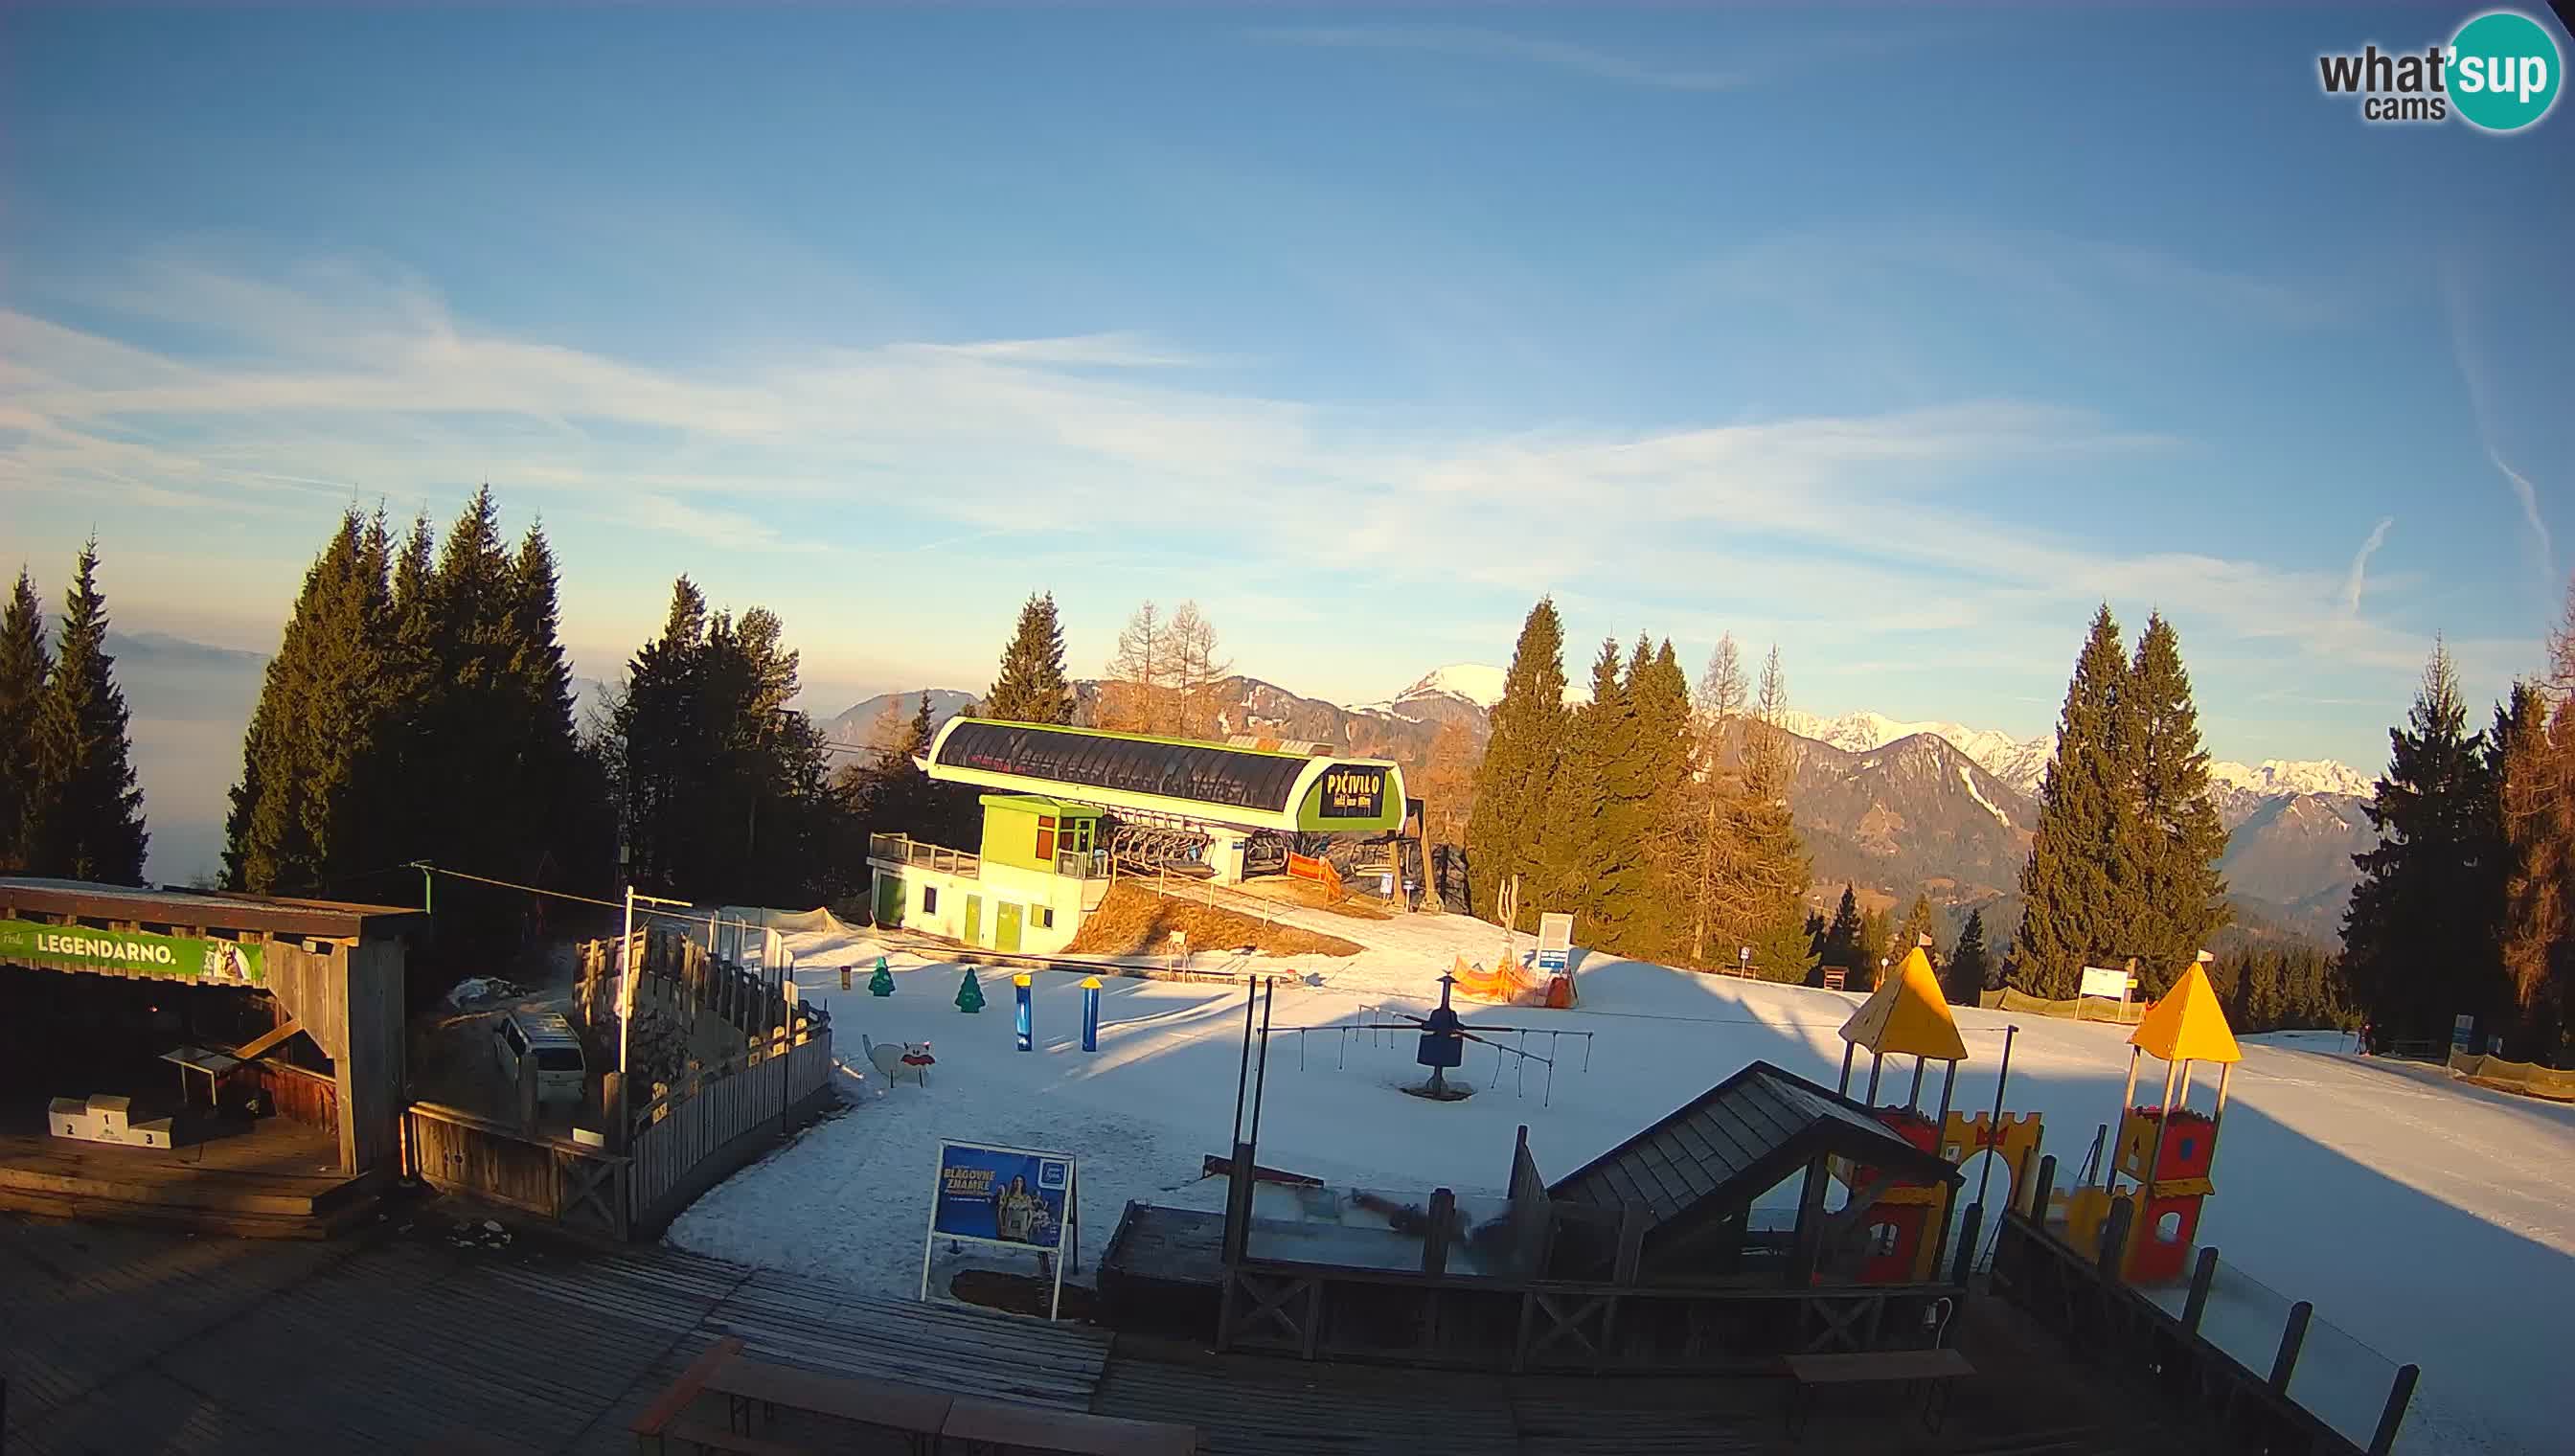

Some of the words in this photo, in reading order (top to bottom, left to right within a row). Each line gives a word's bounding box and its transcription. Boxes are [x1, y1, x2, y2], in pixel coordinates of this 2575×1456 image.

[37, 933, 176, 965] LEGENDARNO.
[103, 1113, 110, 1125] 1
[66, 1124, 74, 1135] 2
[146, 1133, 153, 1145] 3
